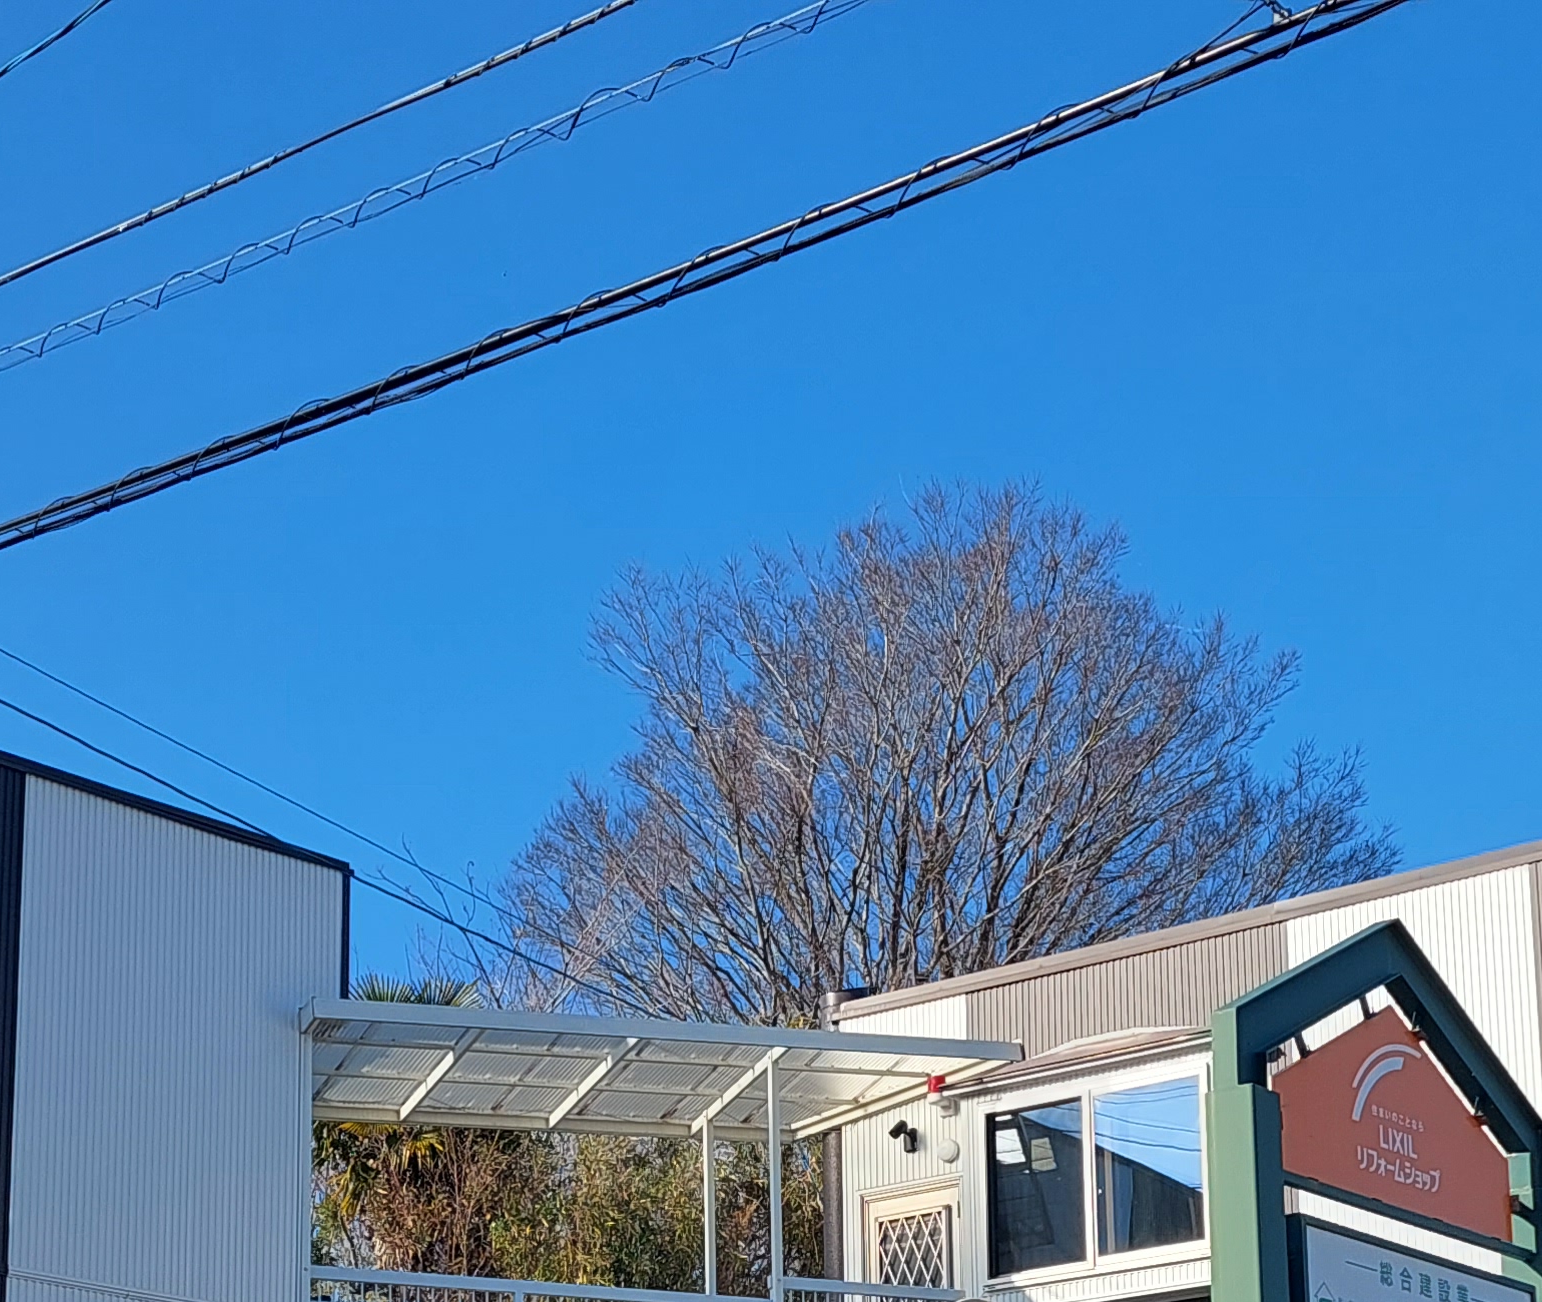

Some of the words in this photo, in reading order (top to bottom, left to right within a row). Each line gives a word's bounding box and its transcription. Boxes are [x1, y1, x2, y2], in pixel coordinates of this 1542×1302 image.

[1371, 1104, 1425, 1133] 住まいのことなら
[1378, 1124, 1419, 1160] LIXIL
[1357, 1145, 1442, 1194] リフォームショップ
